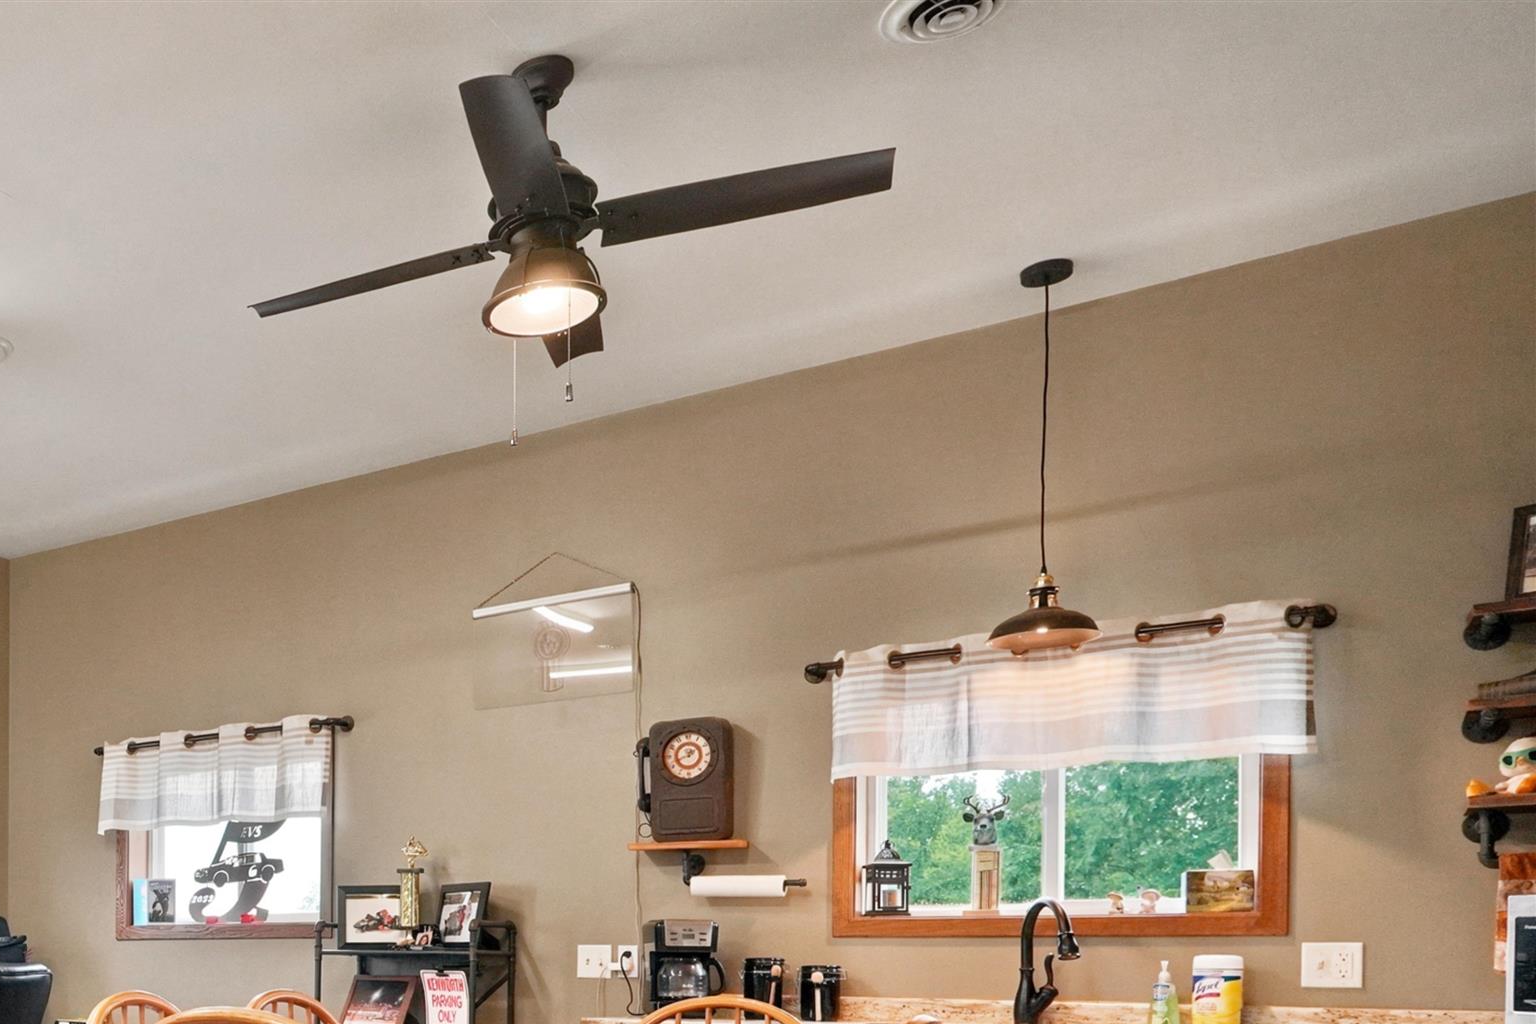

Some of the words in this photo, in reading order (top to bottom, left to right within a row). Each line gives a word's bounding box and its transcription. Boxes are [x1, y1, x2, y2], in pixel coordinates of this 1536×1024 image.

[427, 977, 464, 992] KENWORTH
[431, 994, 463, 1009] PARKING
[437, 1009, 457, 1023] ONLY
